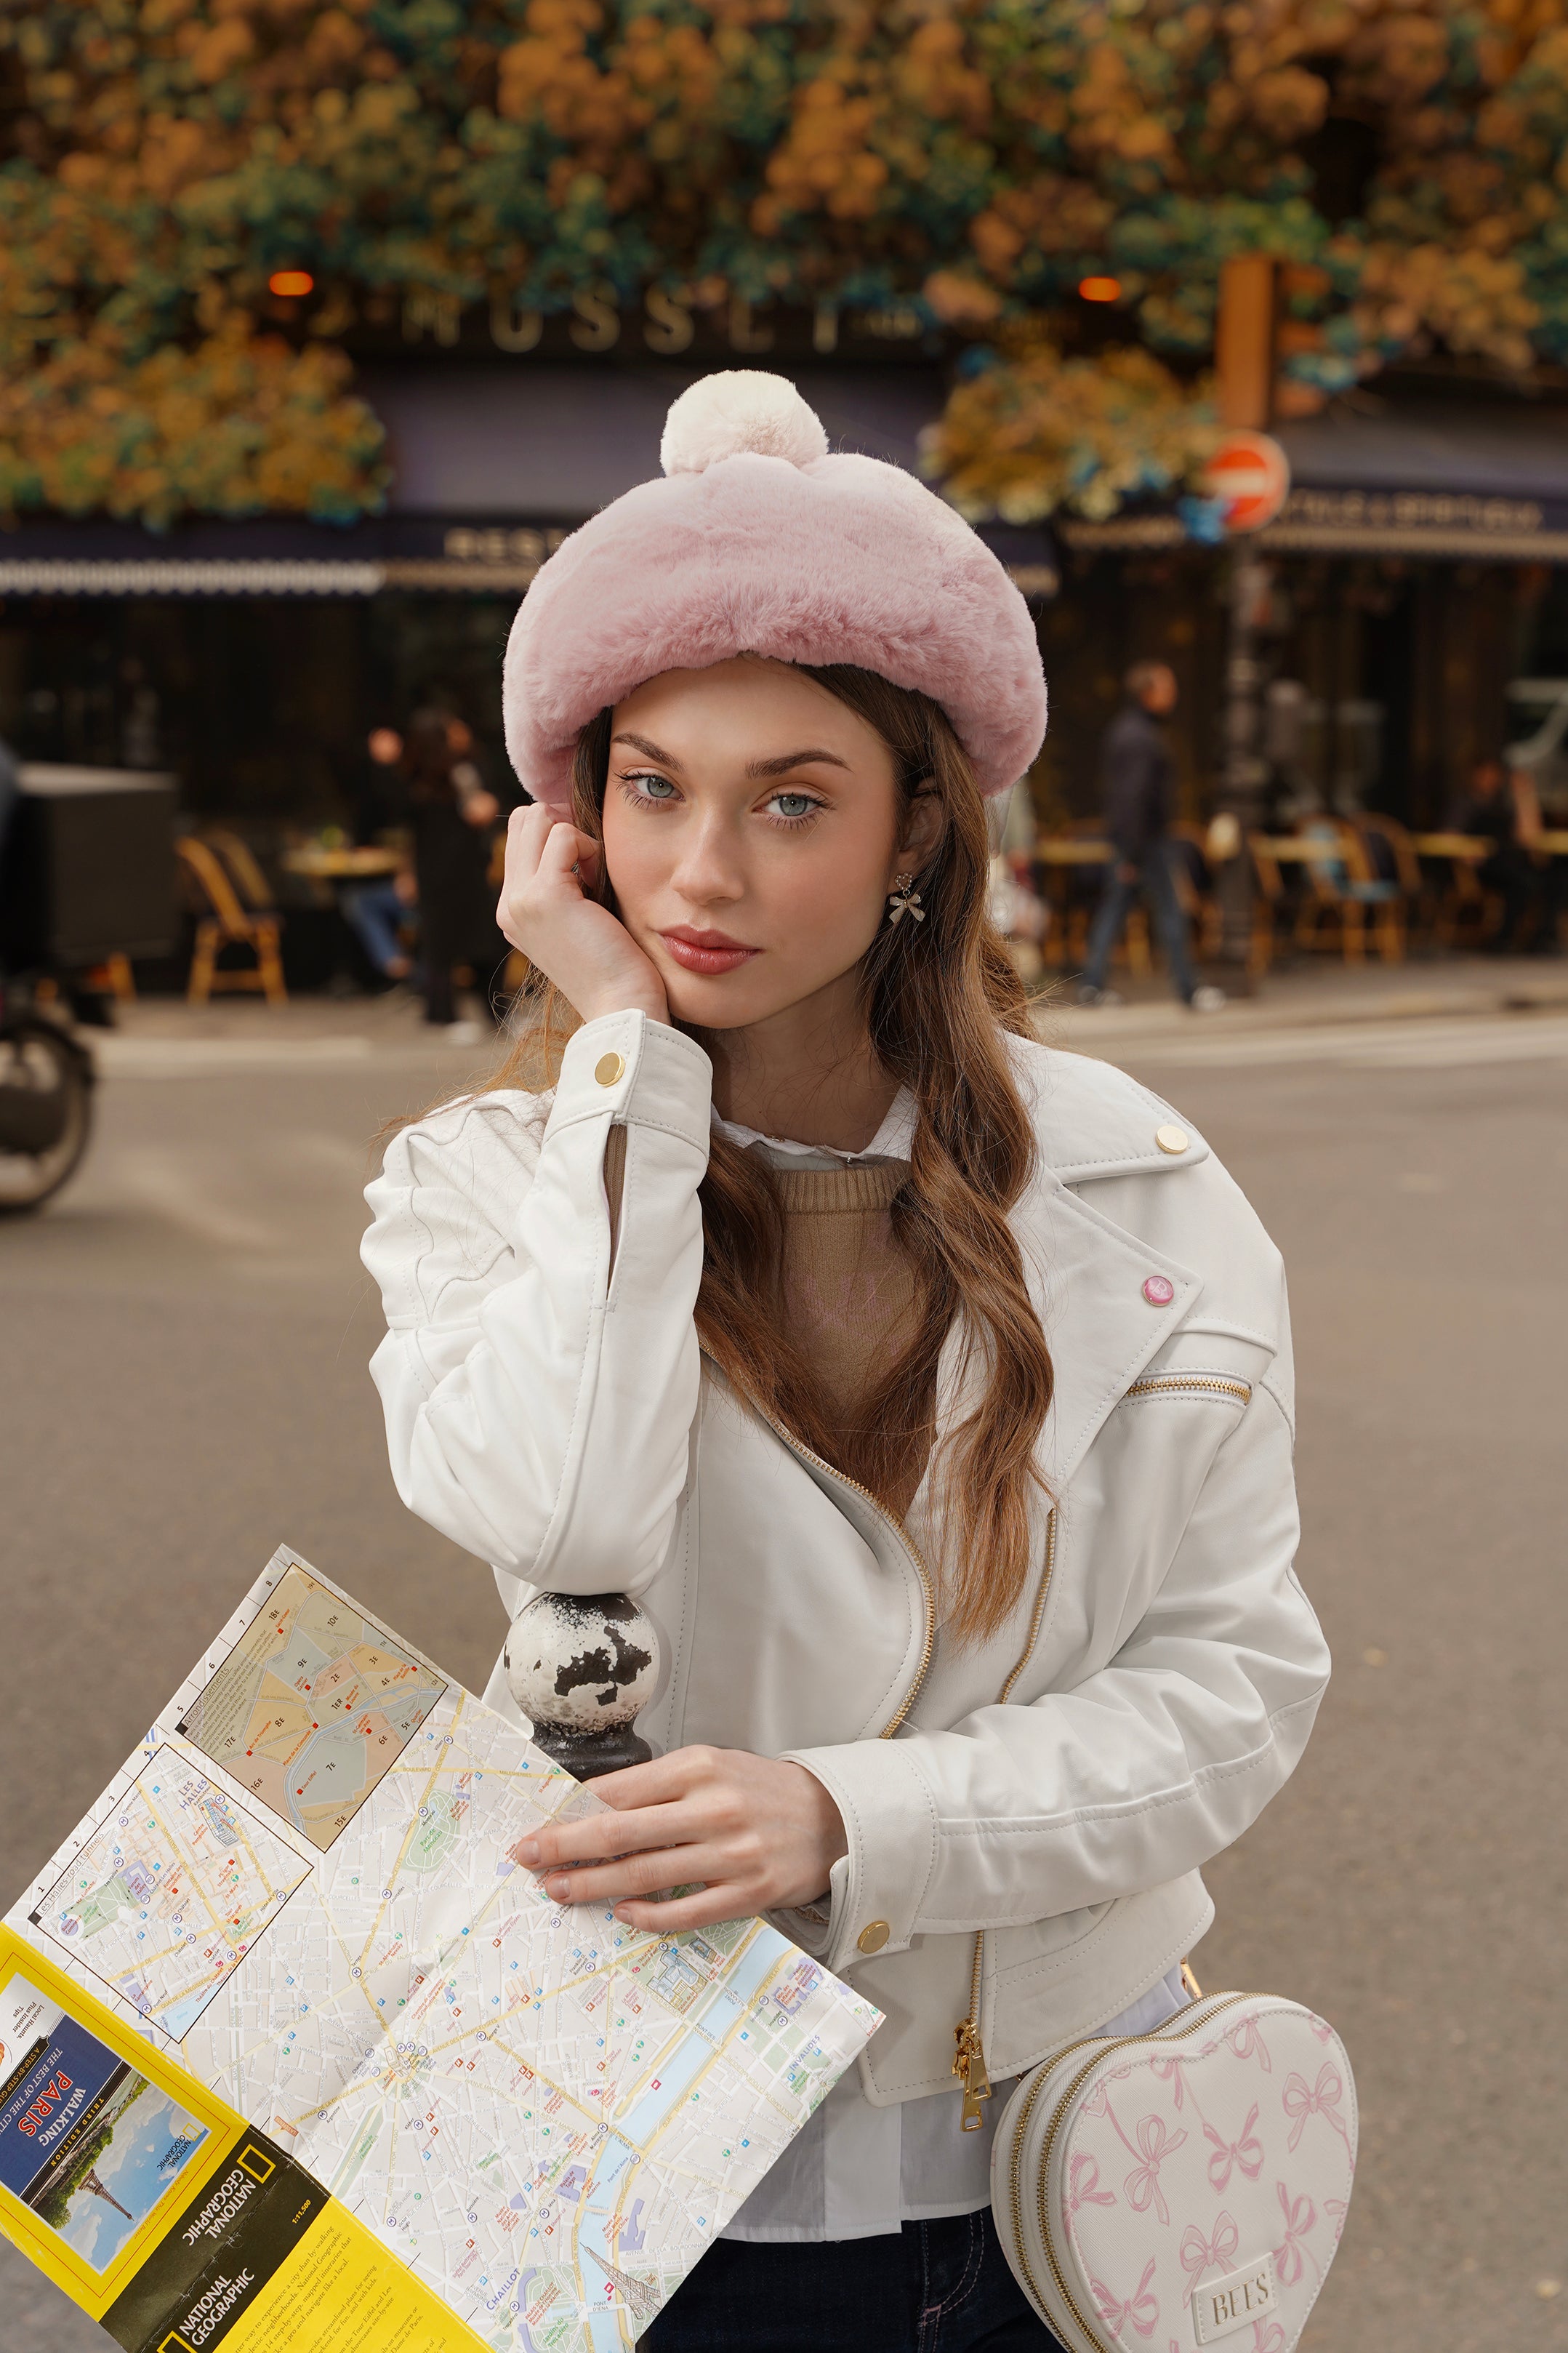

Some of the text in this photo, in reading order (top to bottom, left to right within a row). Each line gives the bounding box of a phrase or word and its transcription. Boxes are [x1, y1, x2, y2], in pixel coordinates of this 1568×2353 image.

[268, 1608, 280, 1621] 18E
[327, 1614, 339, 1627] 10E
[297, 1657, 307, 1668] 9E
[369, 1655, 378, 1664] 3E
[297, 1677, 308, 1691] Garnier
[331, 1672, 340, 1683] 2E
[380, 1676, 390, 1686] 4E
[183, 1667, 230, 1725] Arrondissements
[331, 1698, 343, 1709] 1ER
[345, 1689, 355, 1700] Musée
[349, 1691, 359, 1704] Louvre
[257, 1720, 272, 1738] Triomphe
[274, 1716, 285, 1727] 8E
[401, 1720, 410, 1730] 5E
[224, 1735, 236, 1748] 17E
[282, 1755, 292, 1765] Place
[296, 1730, 312, 1748] Concorde
[378, 1734, 388, 1745] 6E
[326, 1761, 336, 1771] 7E
[179, 1780, 193, 1795] LES
[250, 1776, 263, 1791] 16E
[301, 1771, 317, 1789] Tour Eiffel
[180, 1778, 206, 1809] HALLES
[334, 1814, 347, 1827] 15E
[422, 1810, 435, 1826] Monceau
[192, 1826, 208, 1845] Pompidou
[193, 1823, 204, 1835] Centre
[420, 1834, 431, 1846] Parc
[423, 1829, 443, 1853] Monceau
[38, 1831, 103, 1915] Les Halles-road tunnels
[390, 1885, 405, 1904] Courcelles
[352, 1955, 361, 1966] Ternes
[12, 2005, 23, 2017] Tips
[12, 2002, 36, 2032] Plus Insider
[768, 2010, 782, 2027] Invalides
[17, 2005, 44, 2040] Local Haunts,
[486, 2028, 497, 2041] George
[47, 2048, 63, 2064] THE
[789, 2034, 820, 2071] INVALIDES
[5, 2053, 36, 2091] STEP-BY-STEP
[31, 2064, 49, 2085] BEST
[22, 2084, 34, 2097] OF
[9, 2096, 25, 2114] THE
[17, 2072, 72, 2136] PARIS
[37, 2086, 88, 2146] WALKING
[326, 2106, 340, 2123] Argentine
[405, 2118, 414, 2129] Kléber
[49, 2097, 104, 2166] THIRD EDITION
[590, 2130, 600, 2141] Alma
[590, 2133, 603, 2149] Marceau
[156, 2134, 187, 2170] GEOGRAPHIC
[166, 2138, 191, 2168] NATIONAL
[560, 2176, 570, 2187] Palais
[566, 2176, 576, 2188] Tokyo
[182, 2168, 244, 2245] GEOGRAPHIC
[206, 2179, 255, 2240] NATIONAL
[291, 2199, 313, 2224] 1:11,500
[261, 2290, 299, 2337] neighborhoods.
[297, 2264, 318, 2290] National
[315, 2231, 343, 2265] Geographic
[486, 2267, 520, 2310] CHAILLOT
[179, 2272, 231, 2336] NATIONAL
[190, 2268, 254, 2346] GEOGRAPHIC
[286, 2328, 297, 2341] pro
[294, 2315, 306, 2328] and
[304, 2290, 326, 2317] navigate
[323, 2278, 334, 2290] like
[334, 2258, 349, 2274] local.
[320, 2264, 377, 2336] streamlined plans for seeing
[1210, 2273, 1268, 2326] BEES
[344, 2285, 391, 2346] the Tour Eiffel and Les
[350, 2296, 395, 2352] showcases site-by-site
[393, 2314, 413, 2338] museums
[542, 2325, 558, 2343] Jardins
[548, 2322, 569, 2347] Trocadéro
